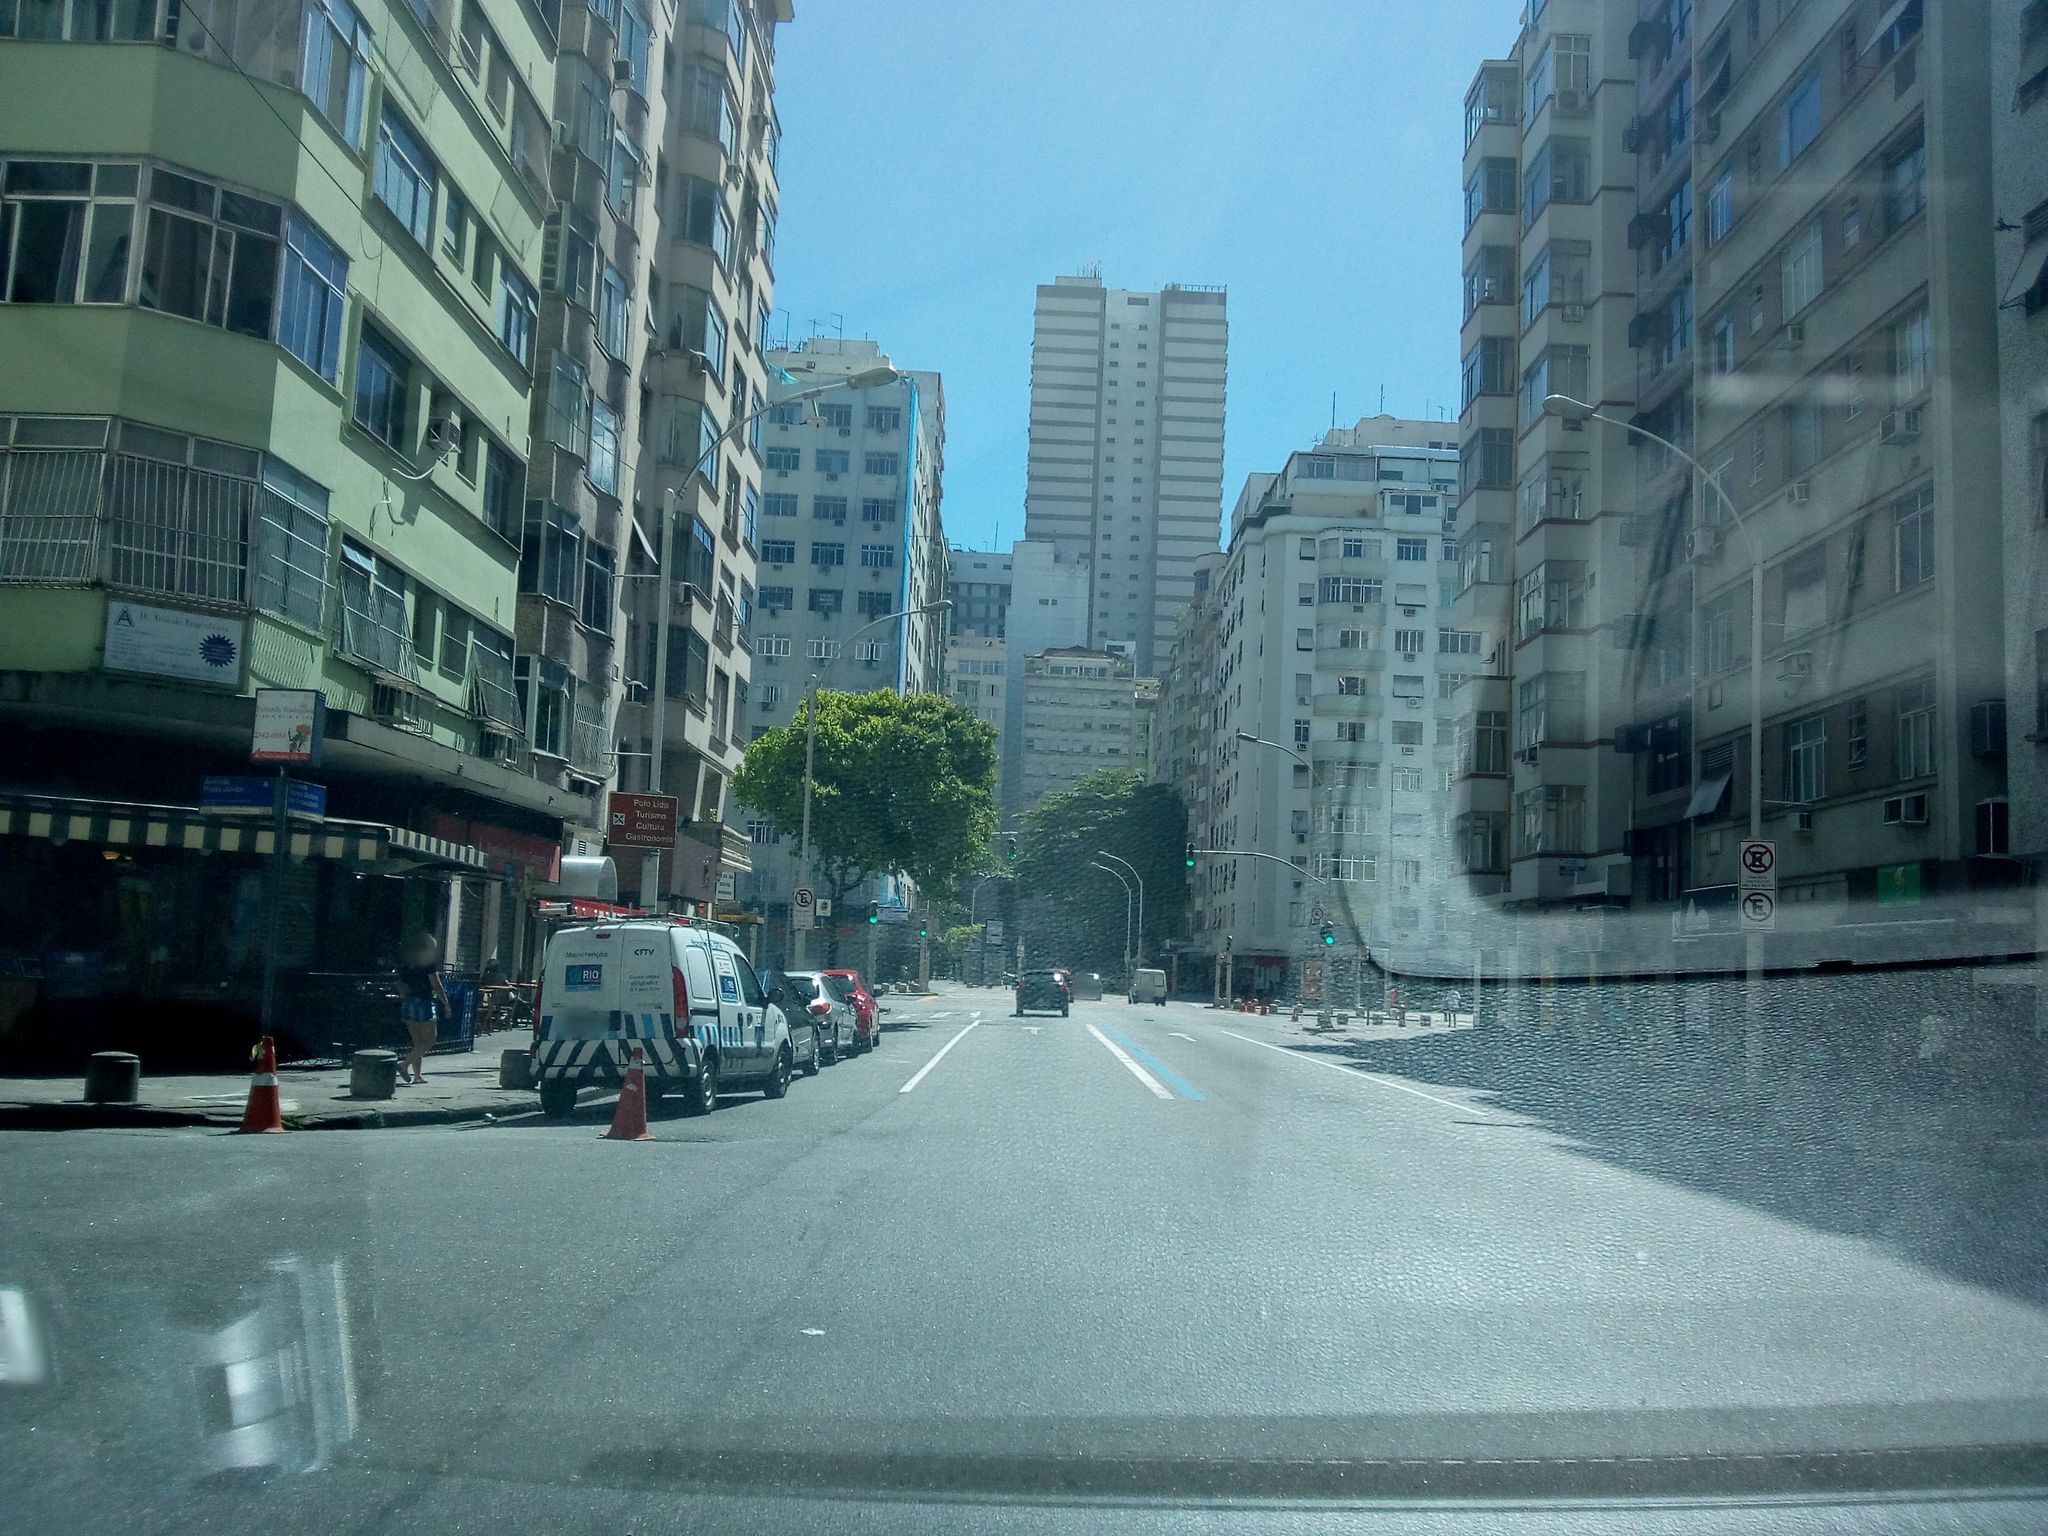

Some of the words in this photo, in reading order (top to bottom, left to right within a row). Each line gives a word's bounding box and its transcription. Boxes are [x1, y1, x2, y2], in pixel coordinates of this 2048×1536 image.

[633, 799, 651, 807] Polo
[635, 811, 667, 820] Turismo
[635, 822, 665, 831] Cultura
[625, 832, 673, 843] Gastronomia
[634, 948, 655, 956] CFTV
[582, 970, 599, 980] RIO
